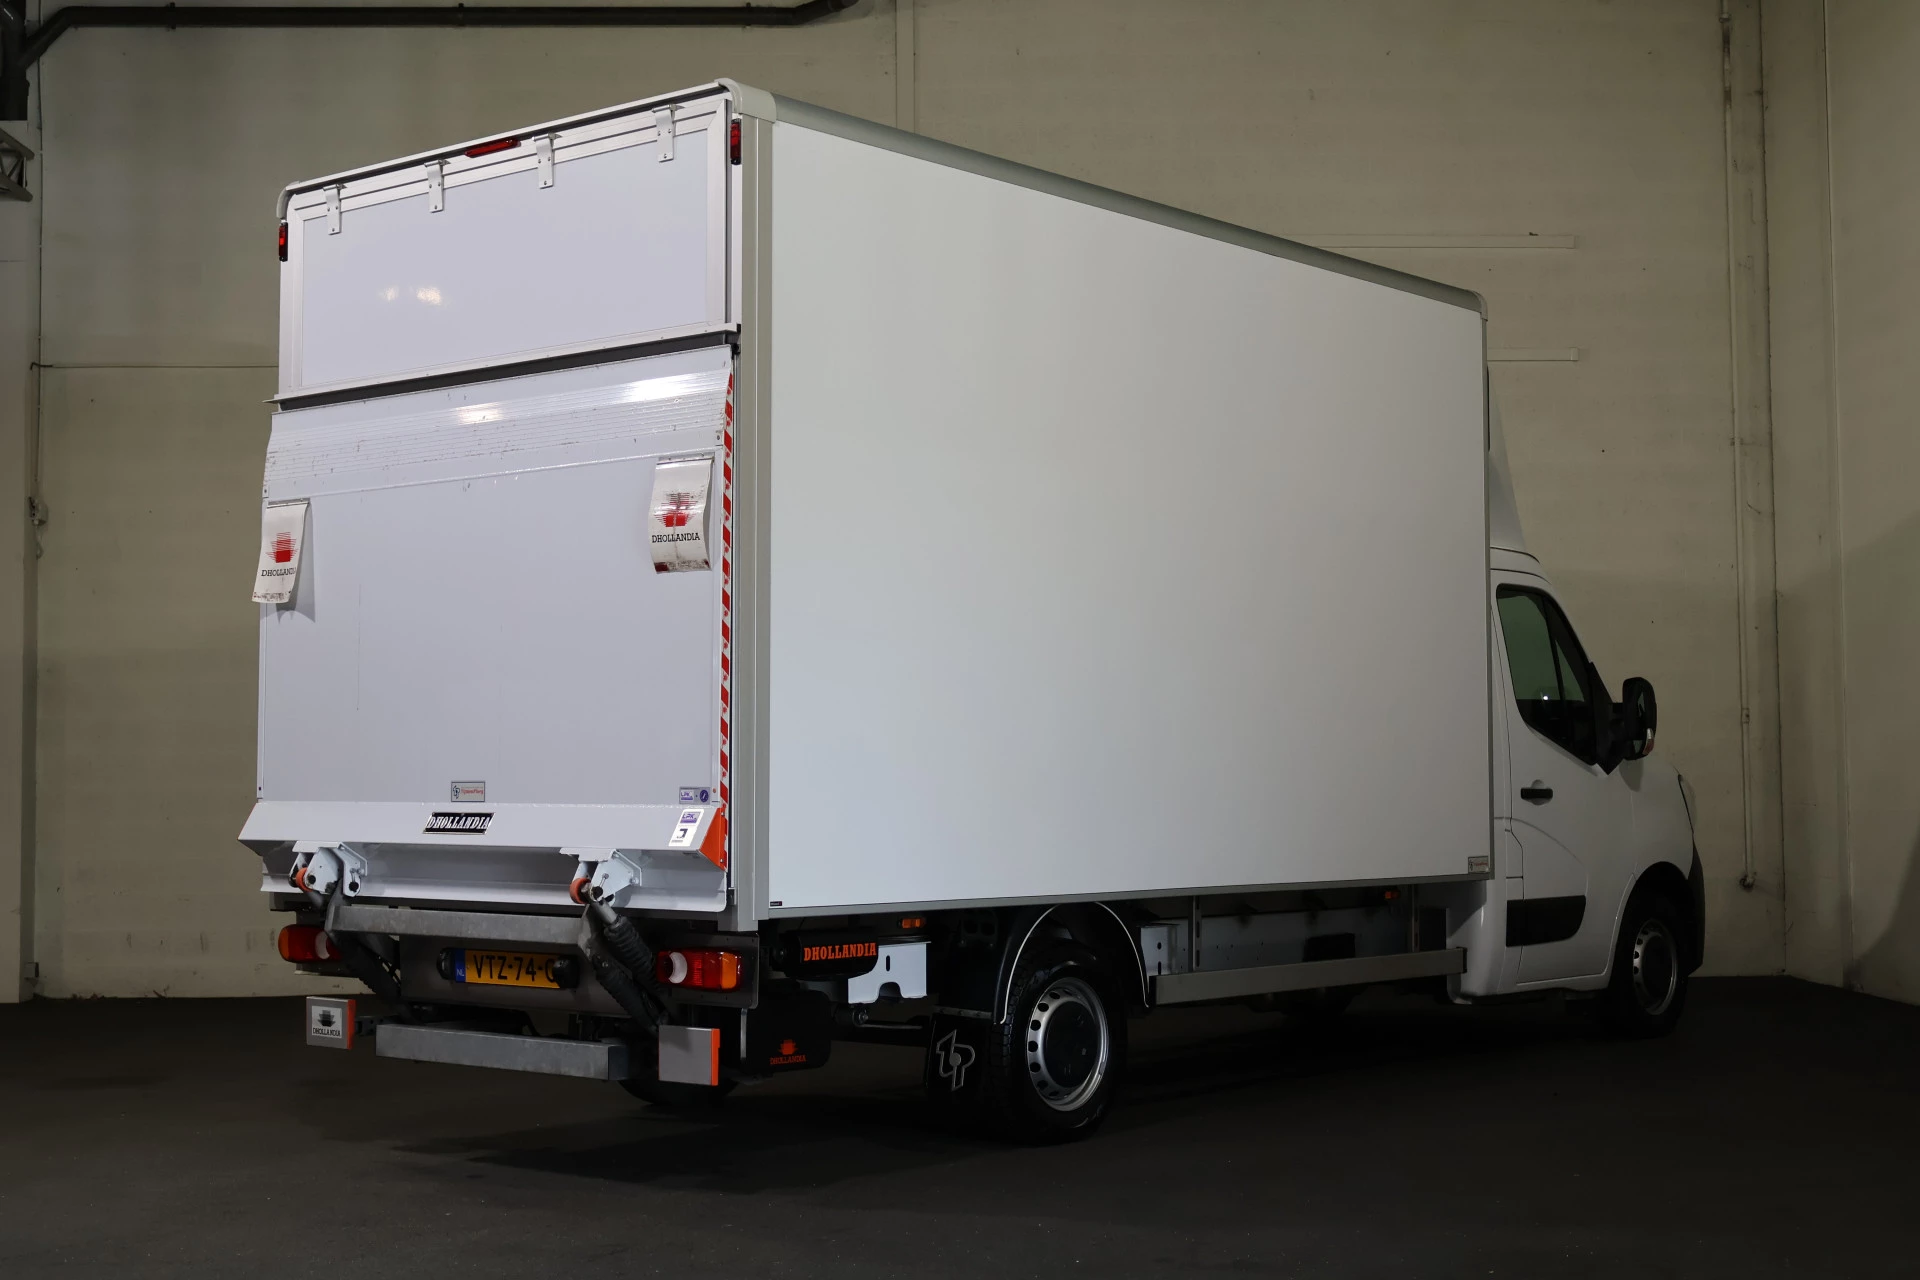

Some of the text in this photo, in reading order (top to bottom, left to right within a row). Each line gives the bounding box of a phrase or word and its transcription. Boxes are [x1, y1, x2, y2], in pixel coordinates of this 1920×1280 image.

[651, 532, 701, 544] DHOLLANDIA
[261, 567, 297, 577] DHOLLAND
[426, 815, 492, 830] DHOLLANDIA
[803, 942, 877, 962] DHOLLANDIA
[456, 968, 465, 977] NL
